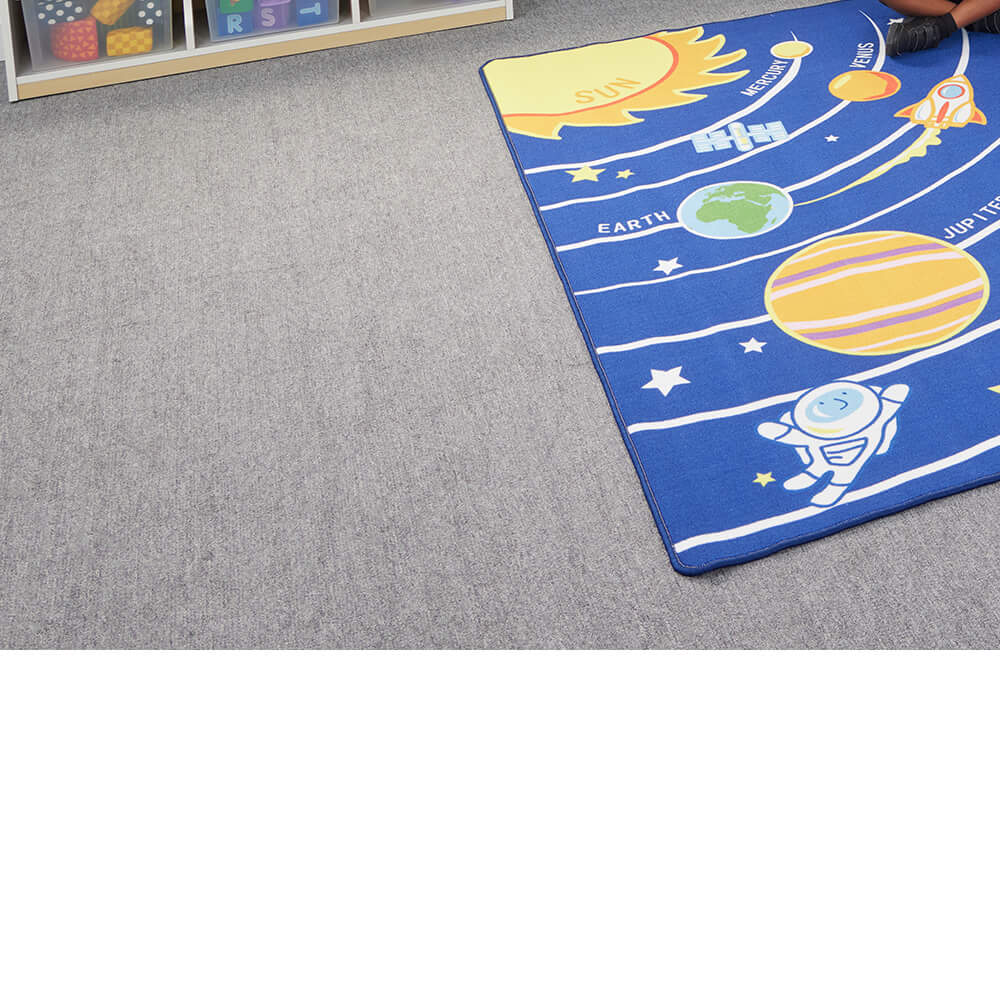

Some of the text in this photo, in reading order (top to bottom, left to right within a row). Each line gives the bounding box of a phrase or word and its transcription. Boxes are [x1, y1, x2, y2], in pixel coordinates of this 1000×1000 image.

[227, 14, 243, 34] R
[261, 8, 275, 27] S
[849, 42, 874, 69] VENUS
[575, 77, 641, 105] SUN
[740, 58, 789, 98] MERCURY
[598, 210, 671, 234] EARTH
